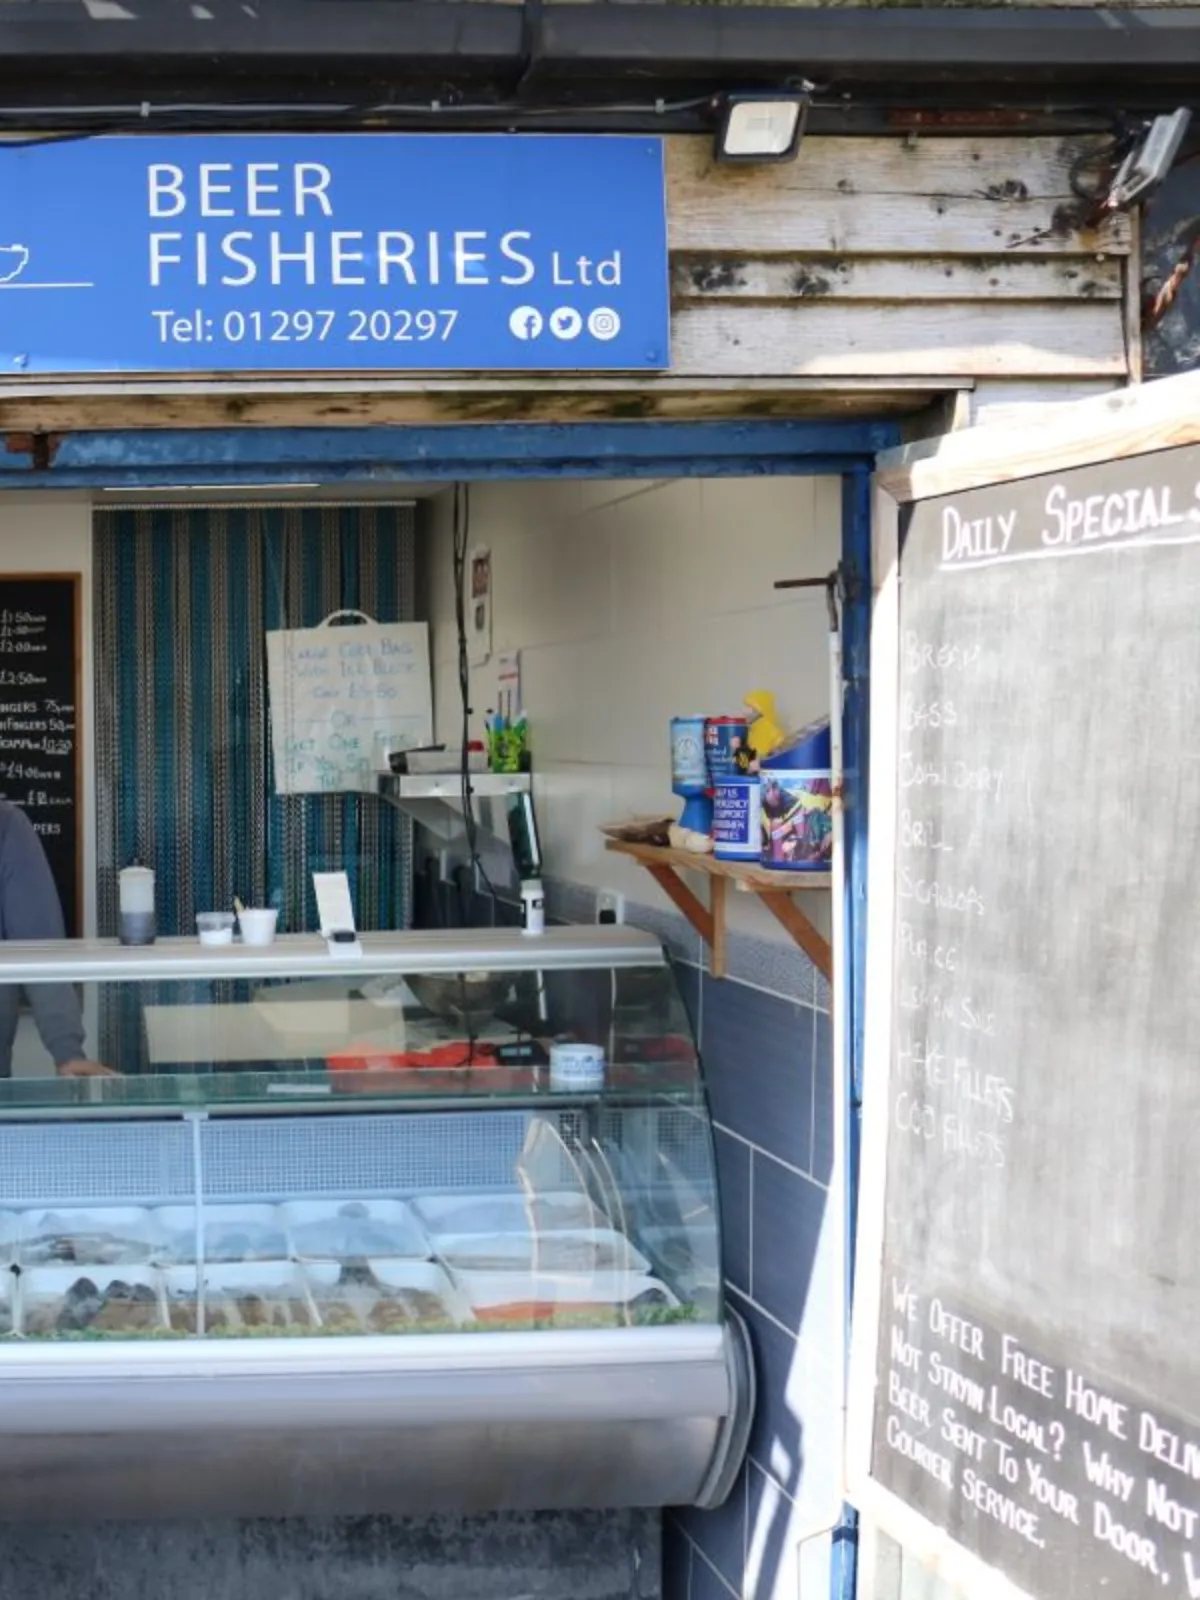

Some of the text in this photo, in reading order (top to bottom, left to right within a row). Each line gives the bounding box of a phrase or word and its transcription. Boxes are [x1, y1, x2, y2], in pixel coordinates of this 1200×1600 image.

[148, 163, 333, 217] BEER
[150, 230, 622, 286] FISHERIES Ltd
[152, 309, 459, 342] Tel: 01297 20297
[942, 505, 1017, 561] DAILY
[891, 1276, 919, 1322] WE
[929, 1298, 985, 1361] OFFER
[1002, 1334, 1054, 1399] FREE
[1065, 1368, 1128, 1441] HOME
[887, 1414, 954, 1490] COURIER
[888, 1369, 931, 1428] BEER
[941, 1407, 987, 1462] SENT
[993, 1438, 1019, 1484] TO
[1026, 1457, 1080, 1526] YOUR
[890, 1324, 922, 1372] NOT
[988, 1384, 1065, 1462] LOCAL?
[1083, 1441, 1135, 1501] WHY
[1146, 1477, 1199, 1540] NOT
